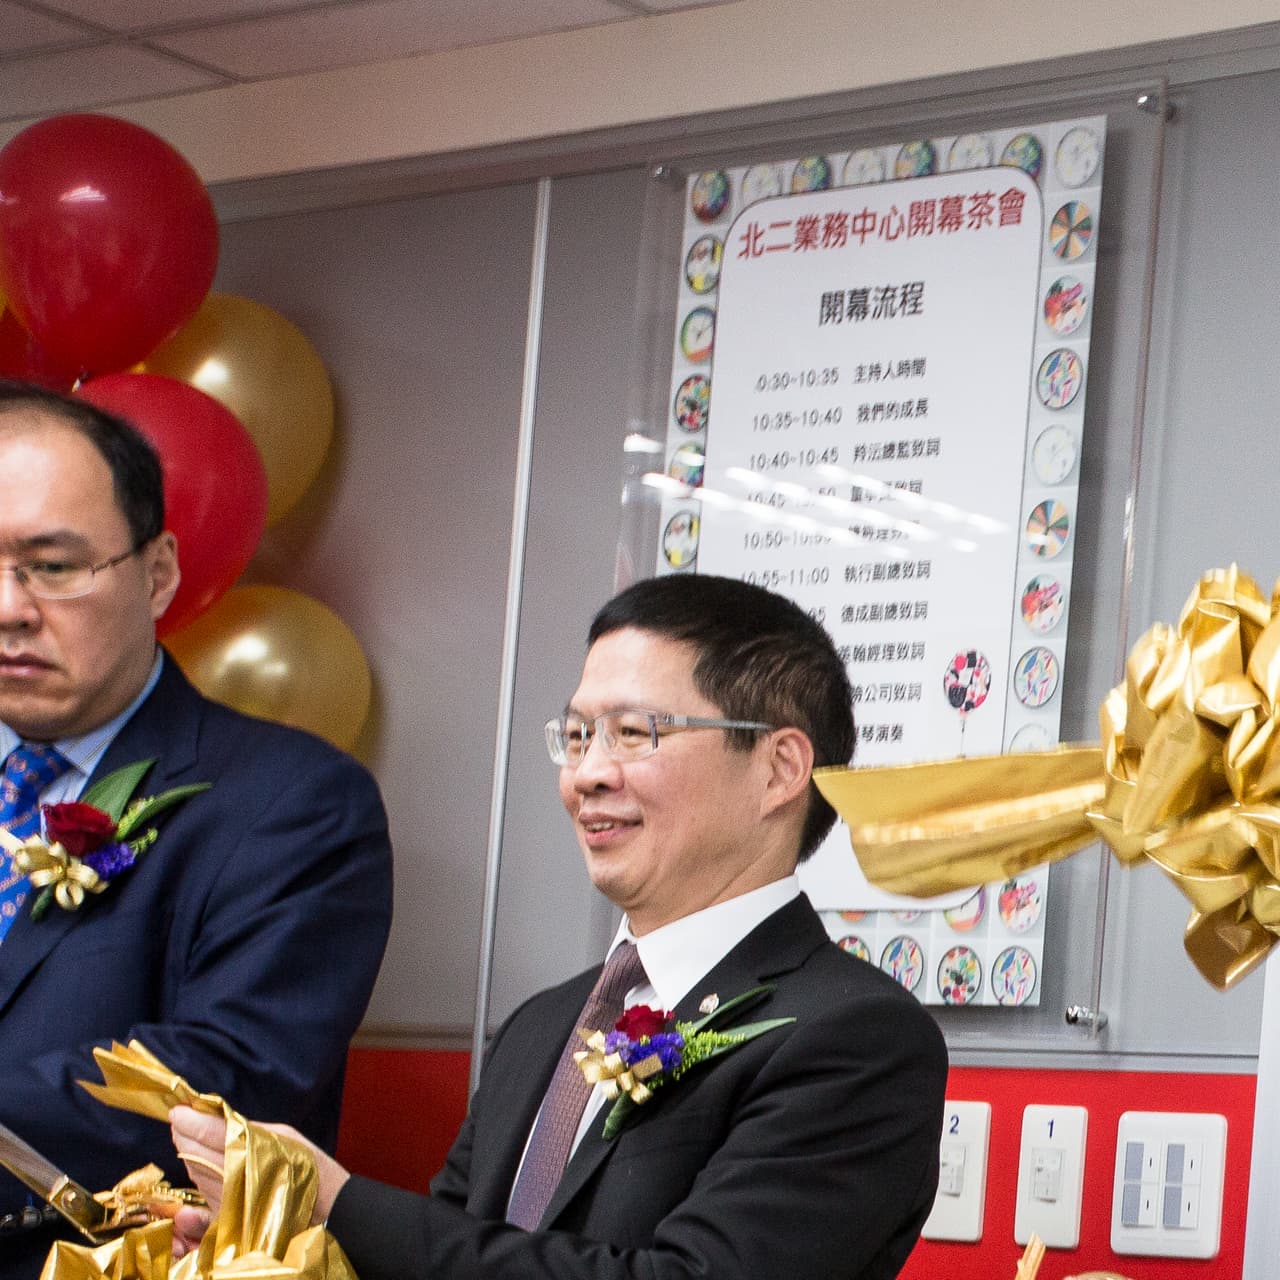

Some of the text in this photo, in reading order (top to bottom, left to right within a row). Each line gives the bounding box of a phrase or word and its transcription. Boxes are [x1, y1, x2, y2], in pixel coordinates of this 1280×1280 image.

[737, 186, 1026, 260] 北二業務中心開幕茶會
[819, 280, 925, 327] 開幕流程
[853, 356, 927, 384] 主持人時間
[856, 397, 929, 425] 我們的成長
[854, 722, 904, 745] 琴演奏
[949, 1114, 960, 1135] 2
[1047, 1119, 1055, 1139] 1
